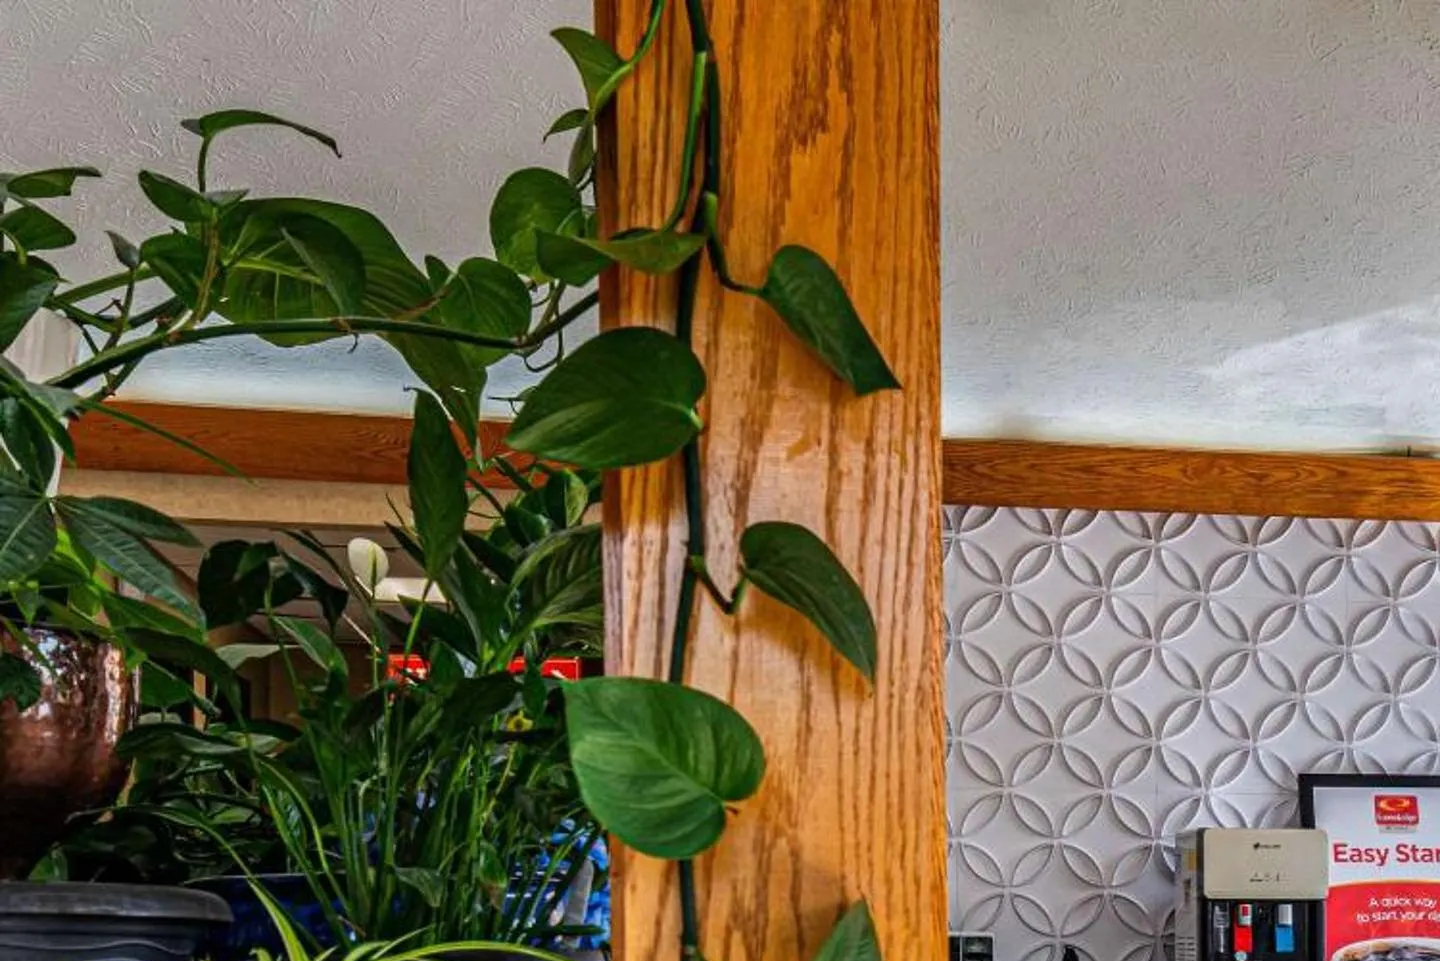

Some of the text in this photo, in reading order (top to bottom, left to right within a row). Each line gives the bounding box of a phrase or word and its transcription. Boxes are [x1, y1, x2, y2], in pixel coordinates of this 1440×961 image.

[1333, 843, 1389, 867] Easy
[1368, 896, 1438, 909] A quick way
[1356, 912, 1370, 924] to
[1372, 910, 1398, 922] start
[1399, 910, 1426, 922] your
